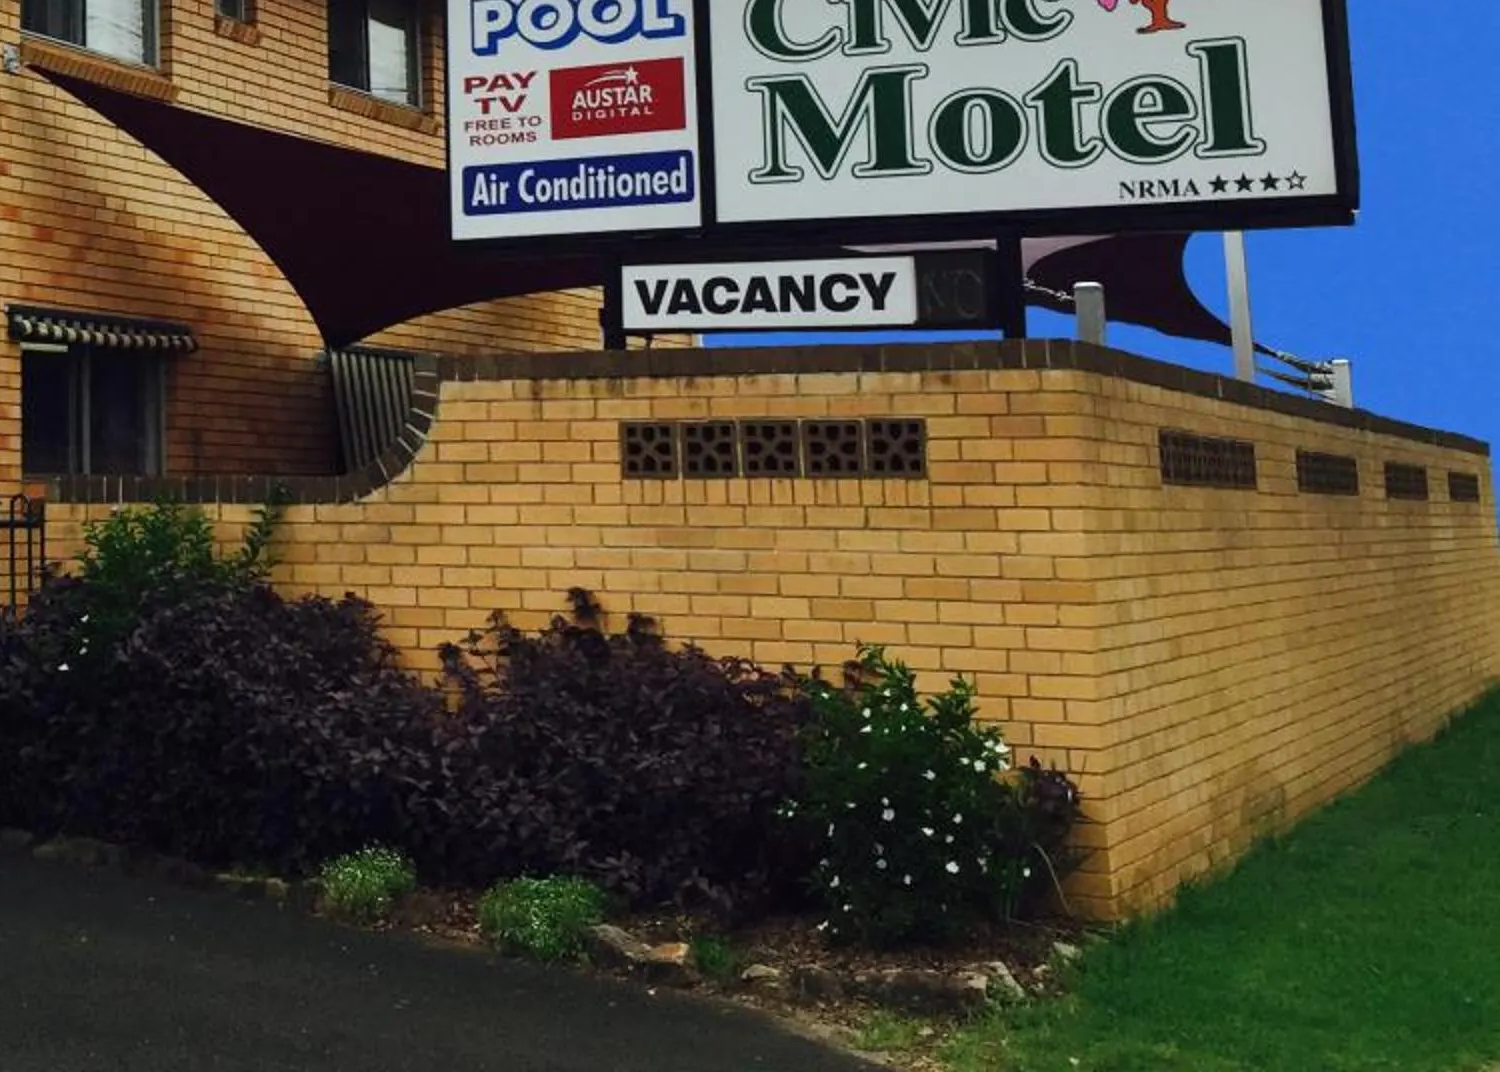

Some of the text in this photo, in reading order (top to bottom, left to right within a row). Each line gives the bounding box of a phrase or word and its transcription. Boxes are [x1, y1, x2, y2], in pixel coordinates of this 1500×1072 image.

[464, 71, 537, 94] PAY
[474, 95, 527, 115] TV
[572, 84, 653, 109] AUSTAR
[572, 105, 654, 121] DIGITAL
[745, 36, 1267, 184] Motel
[465, 115, 542, 132] FREE TO
[469, 131, 537, 147] ROOMS
[471, 156, 688, 207] Air Conditioned
[1119, 177, 1200, 199] NRMA
[634, 272, 896, 316] VACANCY
